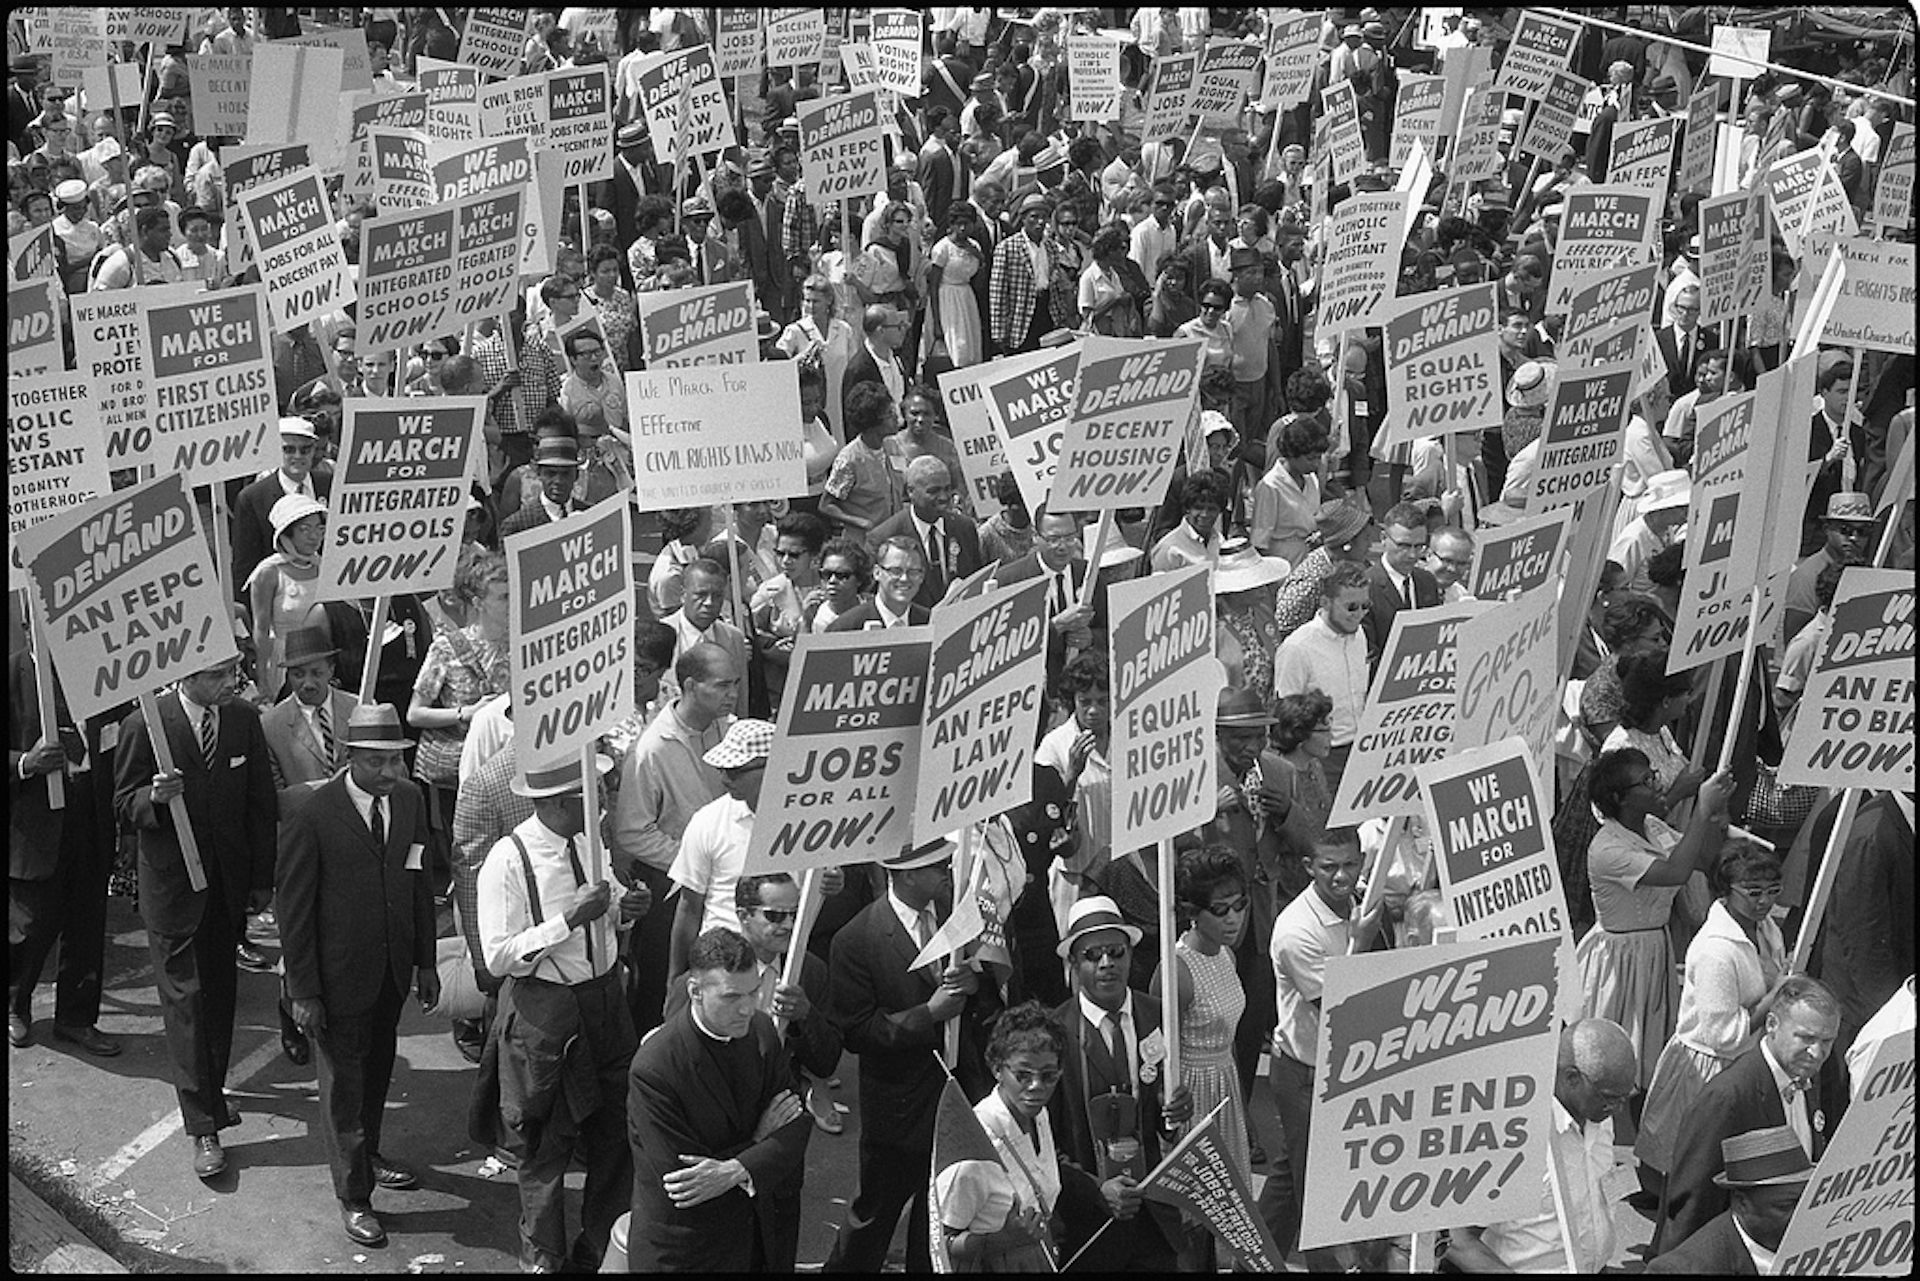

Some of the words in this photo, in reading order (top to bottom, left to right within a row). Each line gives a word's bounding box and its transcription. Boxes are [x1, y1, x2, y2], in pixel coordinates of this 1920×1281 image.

[135, 8, 182, 20] SCHOOLS
[776, 21, 818, 33] DECENT
[134, 23, 178, 37] NOW!
[723, 35, 755, 48] JOBS
[772, 32, 822, 46] HOUSING
[1521, 29, 1568, 50] MARCH
[467, 36, 520, 57] SCHOOLS
[777, 44, 819, 59] NOW!
[877, 44, 917, 61] VOTING
[1275, 55, 1311, 67] DECENT
[467, 52, 512, 72] NOW!
[722, 56, 756, 72] NOW!
[879, 56, 915, 74] RIGHTS
[437, 71, 457, 85] WE
[568, 78, 586, 90] WE
[878, 70, 916, 87] NOW!
[1203, 76, 1240, 88] EQUAL
[425, 85, 475, 102] DEMAND
[553, 88, 601, 109] MARCH
[1153, 95, 1185, 111] JOBS
[429, 109, 471, 127] EQUAL
[569, 107, 588, 115] FOR
[824, 102, 851, 122] WE
[550, 126, 571, 138] JOBS
[574, 122, 590, 134] FOR
[593, 121, 607, 131] ALL
[808, 109, 875, 146] DEMAND
[464, 147, 498, 174] WE
[810, 148, 833, 163] AN
[839, 140, 878, 158] FEPC
[442, 159, 528, 201] DEMAND
[818, 168, 879, 194] NOW!
[826, 157, 868, 176] LAW
[1637, 165, 1666, 180] FEPC
[273, 188, 296, 208] WE
[1594, 197, 1619, 211] WE
[259, 200, 320, 236] MARCH
[282, 223, 307, 239] FOR
[398, 221, 425, 238] WE
[1335, 216, 1388, 236] CATHOLIC
[1570, 211, 1641, 229] MARCH
[373, 231, 447, 263] MARCH
[1340, 230, 1370, 247] JEWS
[1587, 228, 1614, 238] FOR
[264, 251, 292, 272] JOBS
[293, 243, 314, 261] FOR
[316, 233, 335, 252] ALL
[395, 255, 425, 268] FOR
[1556, 258, 1587, 270] CIVIL
[269, 280, 277, 293] A
[277, 262, 319, 287] DECENT
[320, 251, 340, 272] PAY
[365, 265, 451, 297] INTEGRATED
[285, 272, 342, 320] NOW!
[364, 286, 449, 320] SCHOOLS
[679, 295, 717, 324] WE
[77, 308, 94, 322] WE
[189, 304, 222, 325] WE
[369, 306, 445, 345] NOW!
[1420, 297, 1459, 328] WE
[161, 320, 252, 358] MARCH
[655, 307, 747, 353] DEMAND
[1397, 307, 1492, 360] DEMAND
[193, 351, 228, 368] FOR
[1119, 352, 1166, 381] WE
[1405, 352, 1484, 381] EQUAL
[12, 385, 87, 407] TOGETHER
[157, 380, 208, 407] FIRST
[216, 369, 266, 397] CLASS
[1081, 369, 1191, 414] DEMAND
[1405, 372, 1489, 402] RIGHTS
[1584, 379, 1608, 400] WE
[156, 392, 270, 433] CITIZENSHIP
[398, 415, 433, 435] WE
[1406, 391, 1493, 430] NOW!
[1556, 396, 1622, 426] MARCH
[1086, 420, 1173, 440] DECENT
[1573, 422, 1599, 437] FOR
[173, 422, 266, 470] NOW!
[357, 436, 463, 465] MARCH
[646, 451, 683, 472] CIVIL
[687, 446, 731, 469] RIGHTS
[735, 443, 772, 465] LAWS
[1070, 447, 1172, 468] HOUSING
[1541, 439, 1618, 469] INTEGRATED
[386, 464, 427, 478] FOR
[1069, 467, 1163, 498] NOW!
[1536, 467, 1612, 498] SCHOOLS
[12, 476, 70, 496] DIGNITY
[340, 486, 461, 514] INTEGRATED
[81, 502, 134, 555] WE
[335, 518, 455, 547] SCHOOLS
[53, 506, 184, 608] DEMAND
[561, 531, 594, 563] WE
[1510, 535, 1536, 557] WE
[337, 544, 447, 586] NOW!
[529, 544, 619, 609] MARCH
[1478, 552, 1550, 594] MARCH
[66, 600, 114, 641] AN
[122, 563, 202, 615] FEPC
[561, 591, 597, 615] FOR
[1144, 589, 1183, 640] WE
[1697, 600, 1731, 619] FOR
[102, 601, 183, 653] LAW
[522, 600, 628, 670] INTEGRATED
[970, 601, 1014, 651] WE
[94, 615, 212, 697] NOW!
[852, 652, 891, 676] WE
[937, 616, 1039, 708] DEMAND
[1121, 610, 1209, 700] DEMAND
[523, 636, 627, 706] SCHOOLS
[803, 675, 921, 712] MARCH
[1824, 676, 1877, 701] AN
[534, 668, 623, 750] NOW!
[835, 710, 881, 729] FOR
[932, 711, 969, 749] AN
[978, 684, 1035, 725] FEPC
[1128, 691, 1201, 739] EQUAL
[1822, 707, 1861, 732] TO
[951, 726, 1012, 773] LAW
[1126, 727, 1205, 780] RIGHTS
[1359, 725, 1407, 753] CIVIL
[787, 742, 904, 785] JOBS
[1383, 746, 1446, 769] LAWS
[783, 790, 833, 809] FOR
[848, 786, 891, 801] ALL
[932, 749, 1025, 823] NOW!
[1127, 760, 1207, 830] NOW!
[1467, 773, 1500, 806] WE
[768, 806, 896, 857] NOW!
[1449, 795, 1534, 854] MARCH
[1480, 842, 1514, 867] FOR
[1453, 863, 1551, 927] INTEGRATED
[1403, 959, 1489, 1018] WE
[1338, 984, 1548, 1084] DEMAND
[1343, 1089, 1415, 1131] AN
[1431, 1074, 1536, 1117] END
[1344, 1134, 1405, 1170] TO
[1418, 1117, 1529, 1159] BIAS
[1192, 1166, 1226, 1199] JOBS
[1340, 1152, 1525, 1222] NOW!
[1826, 1189, 1915, 1229] EQUAL
